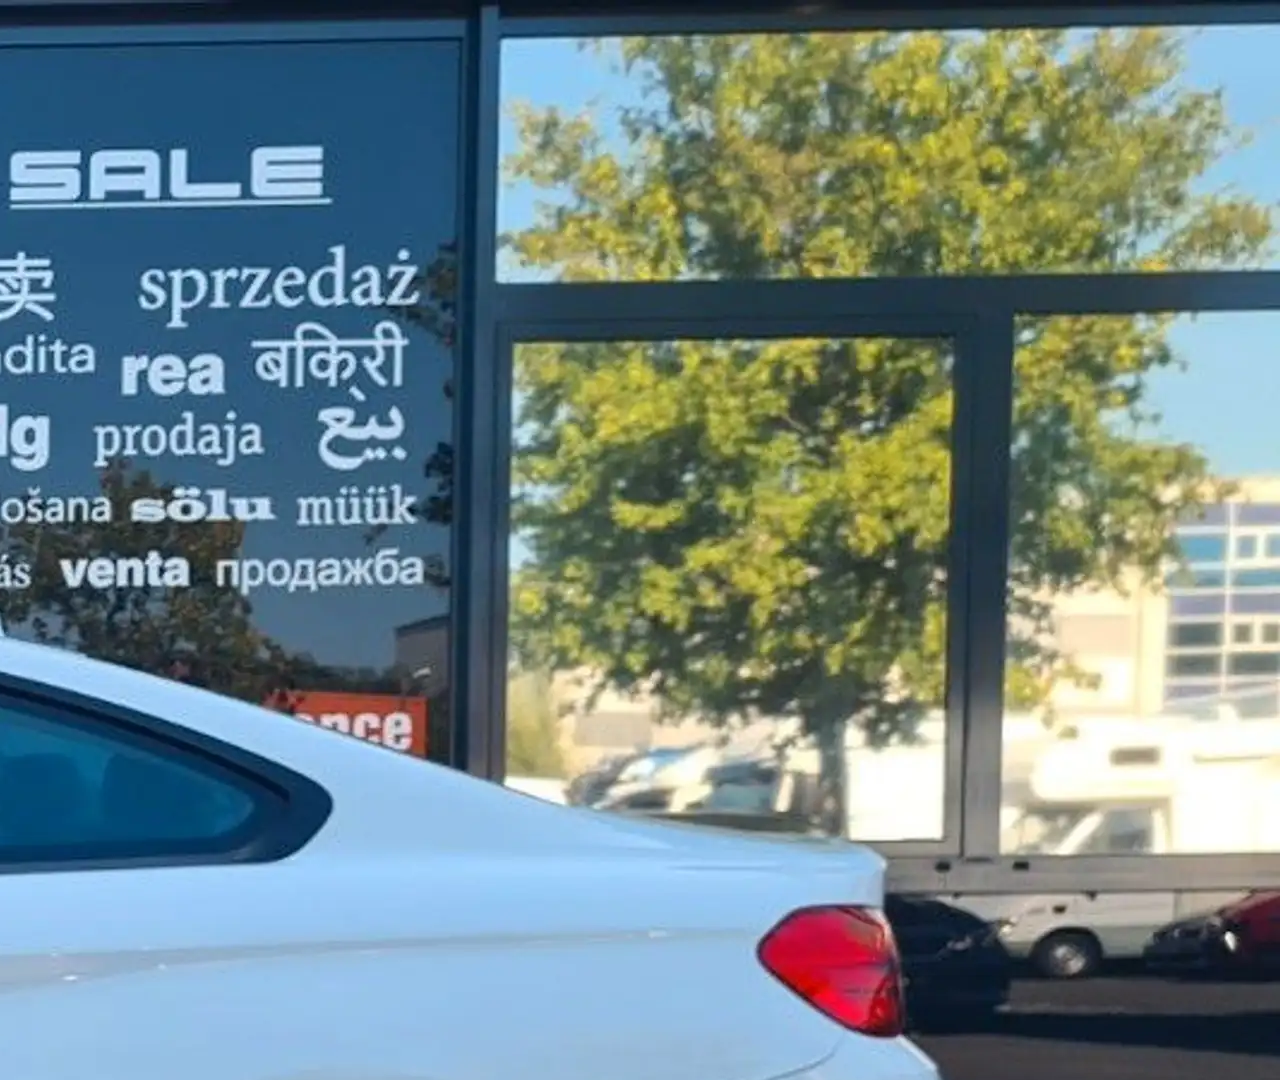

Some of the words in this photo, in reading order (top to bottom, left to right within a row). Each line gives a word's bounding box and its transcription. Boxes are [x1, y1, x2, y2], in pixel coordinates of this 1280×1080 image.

[9, 146, 324, 200] SALE
[139, 245, 418, 329] sprzedaż
[121, 353, 225, 396] rea
[93, 410, 264, 467] prodaja
[131, 487, 276, 522] sölu
[297, 484, 417, 526] müük
[59, 550, 190, 589] venta
[216, 548, 424, 596] продажба
